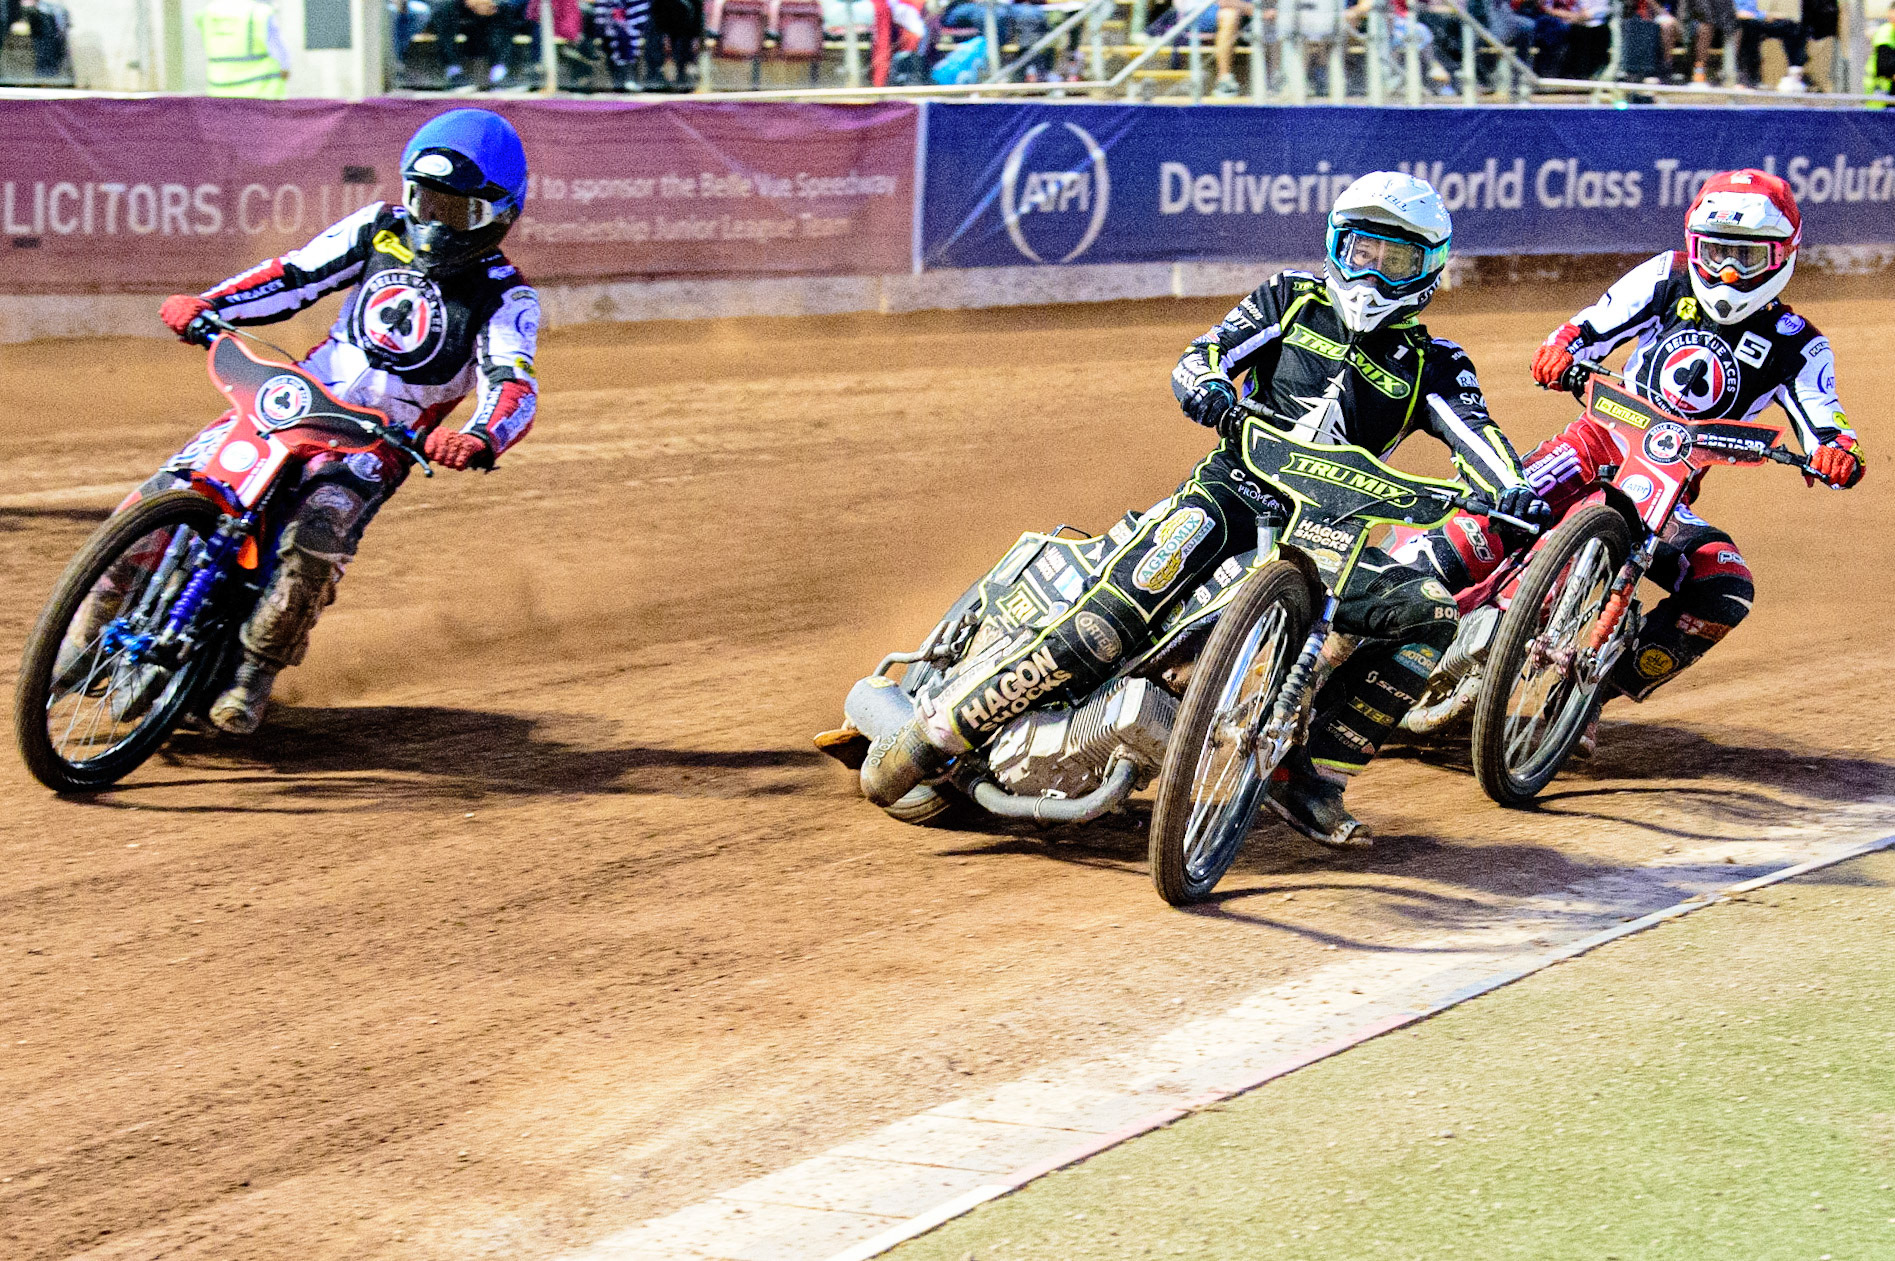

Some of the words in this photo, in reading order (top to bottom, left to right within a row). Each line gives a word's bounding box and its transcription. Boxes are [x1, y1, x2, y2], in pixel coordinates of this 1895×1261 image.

[1159, 160, 1357, 214] Deliverin
[1535, 158, 1643, 207] Class
[1354, 352, 1401, 393] MIX
[1665, 333, 1699, 353] BELLE
[1722, 360, 1737, 393] ACES
[1296, 457, 1351, 481] TRU
[1348, 473, 1409, 504] MIX
[1141, 515, 1201, 581] AGROMIX
[1293, 529, 1349, 552] SHOCKS
[1298, 519, 1355, 546] HAGON
[960, 645, 1059, 728] HAGON
